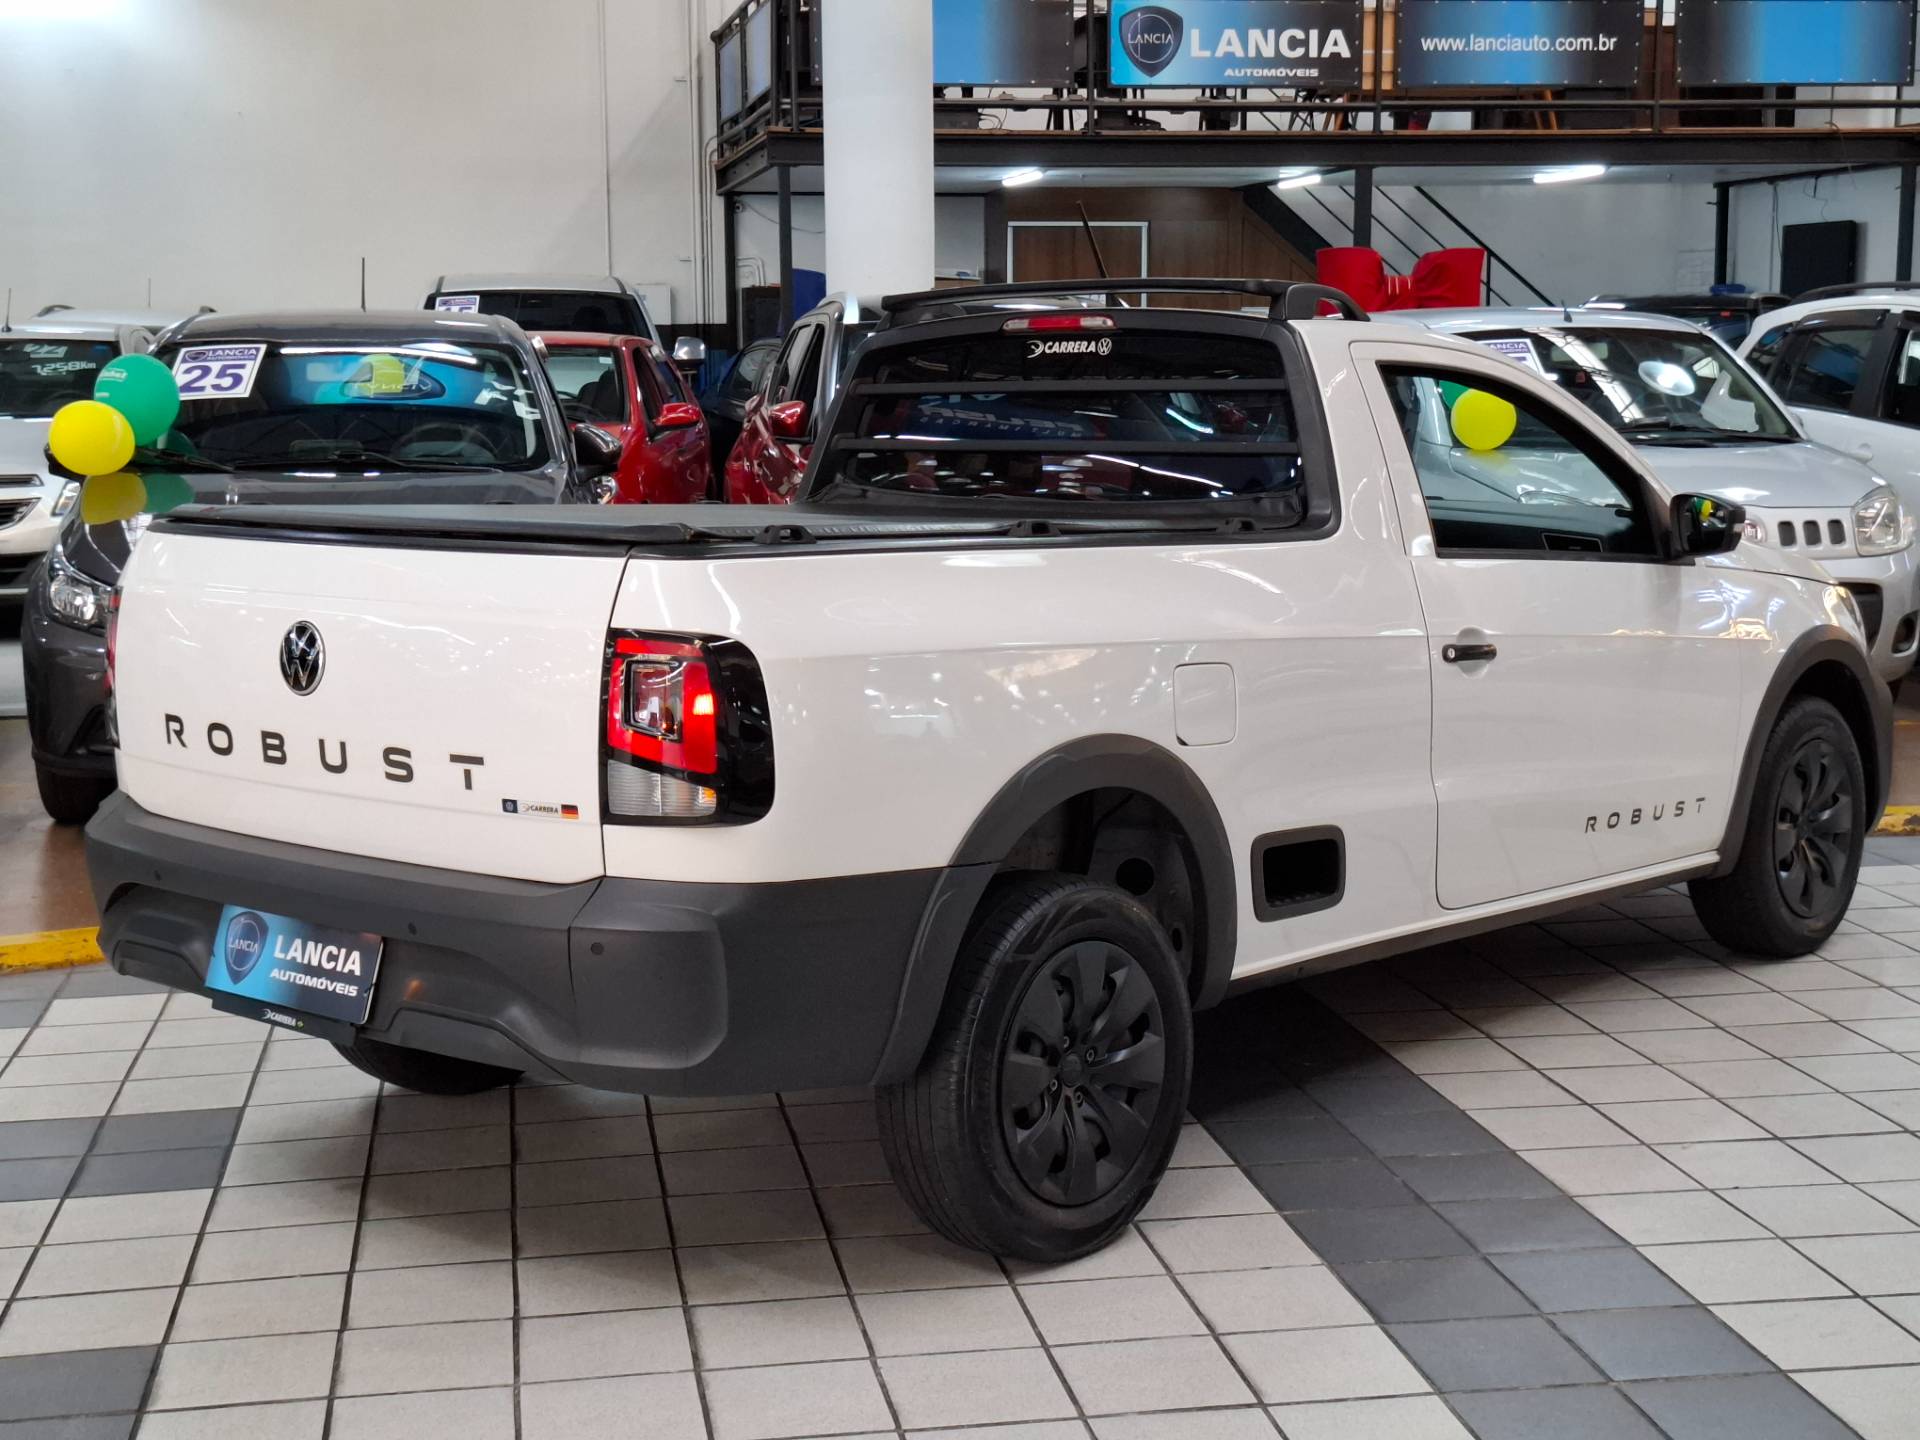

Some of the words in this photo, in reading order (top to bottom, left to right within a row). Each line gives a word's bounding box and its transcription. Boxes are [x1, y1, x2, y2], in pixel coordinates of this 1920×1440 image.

[1128, 33, 1173, 44] LANCIA
[1190, 29, 1351, 58] LANCIA
[1421, 33, 1618, 51] www.lanciauto.com.br
[1224, 66, 1319, 77] AUTOMÓVEIS
[209, 349, 256, 357] LANCIA
[1044, 341, 1096, 354] CARRERA
[179, 363, 247, 393] 25
[164, 713, 484, 791] ROBUST
[530, 804, 559, 814] CARRERA
[1584, 797, 1706, 834] ROBUST
[229, 939, 258, 954] LANCIA
[273, 934, 362, 977] LANCIA
[270, 967, 359, 998] AUTOMÓVEIS
